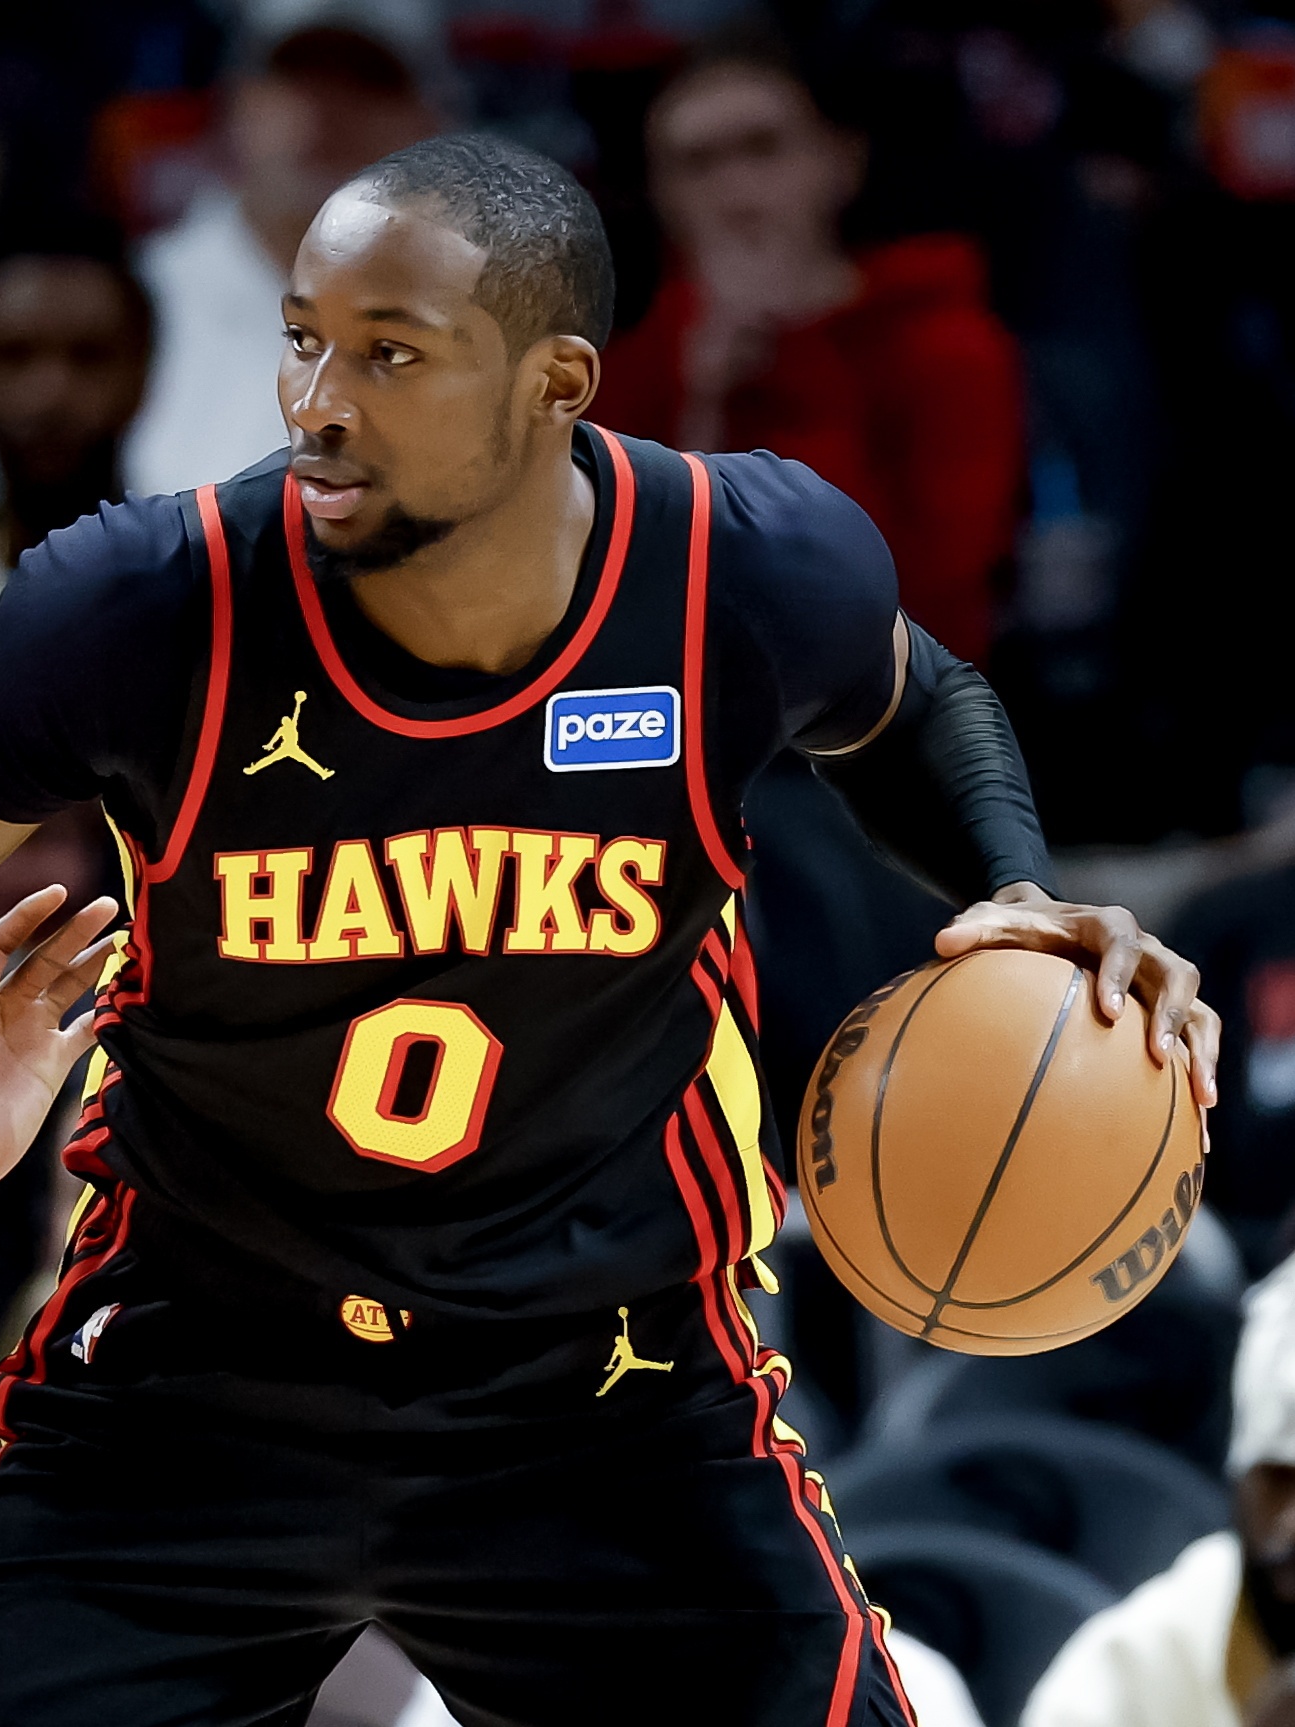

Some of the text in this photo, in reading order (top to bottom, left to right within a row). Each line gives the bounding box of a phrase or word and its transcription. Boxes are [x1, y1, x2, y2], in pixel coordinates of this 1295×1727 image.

[557, 709, 666, 751] paze
[214, 826, 667, 964] HAWKS
[326, 998, 503, 1173] 0
[349, 1303, 388, 1326] AT
